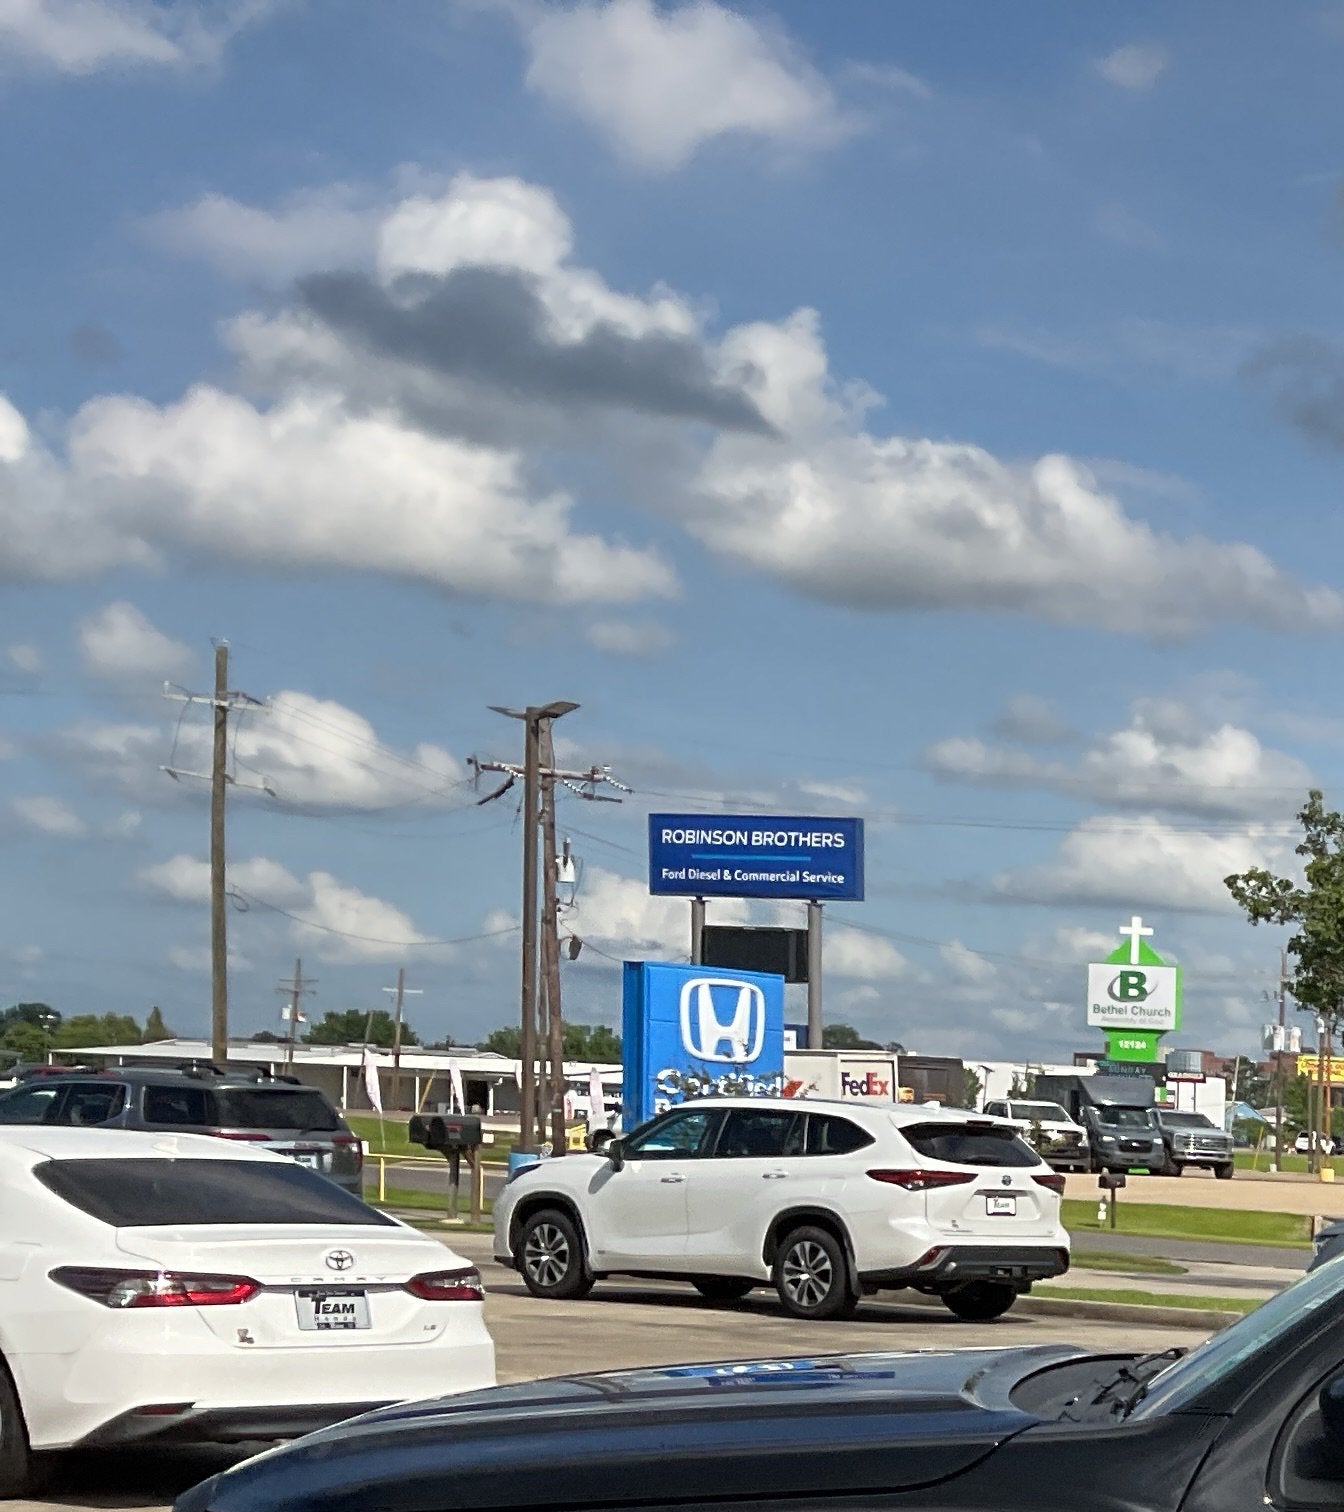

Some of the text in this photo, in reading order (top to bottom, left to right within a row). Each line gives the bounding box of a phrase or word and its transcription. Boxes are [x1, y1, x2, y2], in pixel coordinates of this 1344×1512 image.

[662, 829, 845, 848] ROBINSON BROTHERS
[662, 867, 845, 884] Ford Diesel & Commercial Service
[1092, 1003, 1171, 1018] Bethel Church
[841, 1071, 890, 1097] FedEx
[311, 1294, 355, 1315] TEAM
